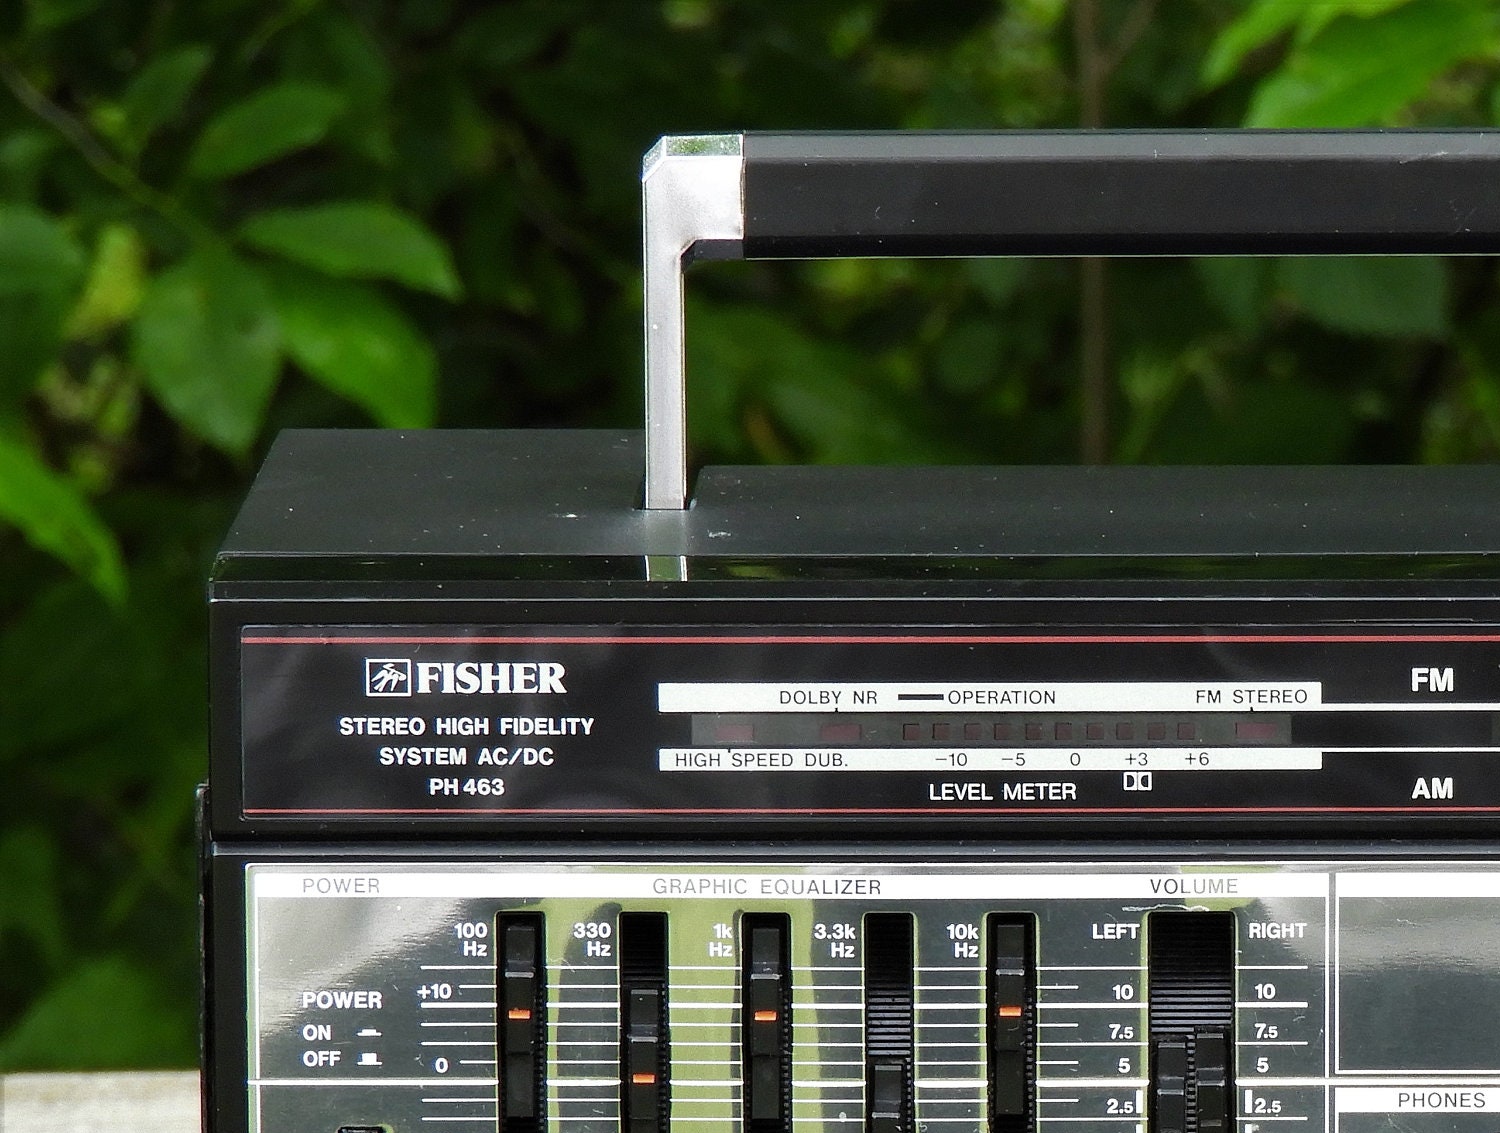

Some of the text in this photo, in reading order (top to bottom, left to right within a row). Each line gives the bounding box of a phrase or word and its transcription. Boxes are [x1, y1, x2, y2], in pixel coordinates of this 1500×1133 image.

[417, 663, 567, 693] FISHER
[1412, 668, 1453, 691] FM
[780, 691, 1055, 704] DOLBY NR OPERATION
[1197, 690, 1307, 703] FM STEREO
[340, 717, 594, 735] STEREO HIGH FIDELITY
[380, 747, 553, 765] SYSTEM AC/DC
[676, 753, 847, 767] HIGH SPEED DUB.
[1070, 752, 1209, 766] 0 +3 +6
[430, 778, 504, 795] PH 463
[930, 783, 1076, 800] LEVEL METER
[1412, 778, 1453, 799] AM
[304, 878, 379, 893] POWER
[653, 879, 880, 894] GRAPHIC EQUALIZER
[1151, 879, 1237, 894] VOLUME
[454, 923, 487, 938] 100
[573, 923, 611, 938] 330
[713, 924, 732, 938] 1k
[815, 924, 855, 939] 3.3k
[947, 924, 979, 939] 10k
[1093, 924, 1140, 939] LEFT
[1249, 923, 1307, 938] RIGHT
[464, 941, 487, 956] Hz
[587, 941, 611, 956] Hz
[710, 942, 732, 956] Hz
[831, 942, 854, 957] Hz
[955, 942, 978, 957] Hz
[417, 984, 451, 999] +10
[1113, 985, 1133, 1000] 10
[1255, 984, 1275, 999] 10
[303, 992, 382, 1008] POWER
[303, 1025, 330, 1040] ON
[1109, 1024, 1133, 1039] 7.5
[1255, 1023, 1278, 1038] 7.5
[303, 1051, 341, 1066] OFF
[435, 1058, 448, 1073] 0
[1119, 1058, 1130, 1073] 5
[1257, 1058, 1269, 1072] 5
[1107, 1099, 1133, 1113] 2.5
[1255, 1098, 1281, 1116] 2.5
[1399, 1093, 1485, 1108] PHONES
